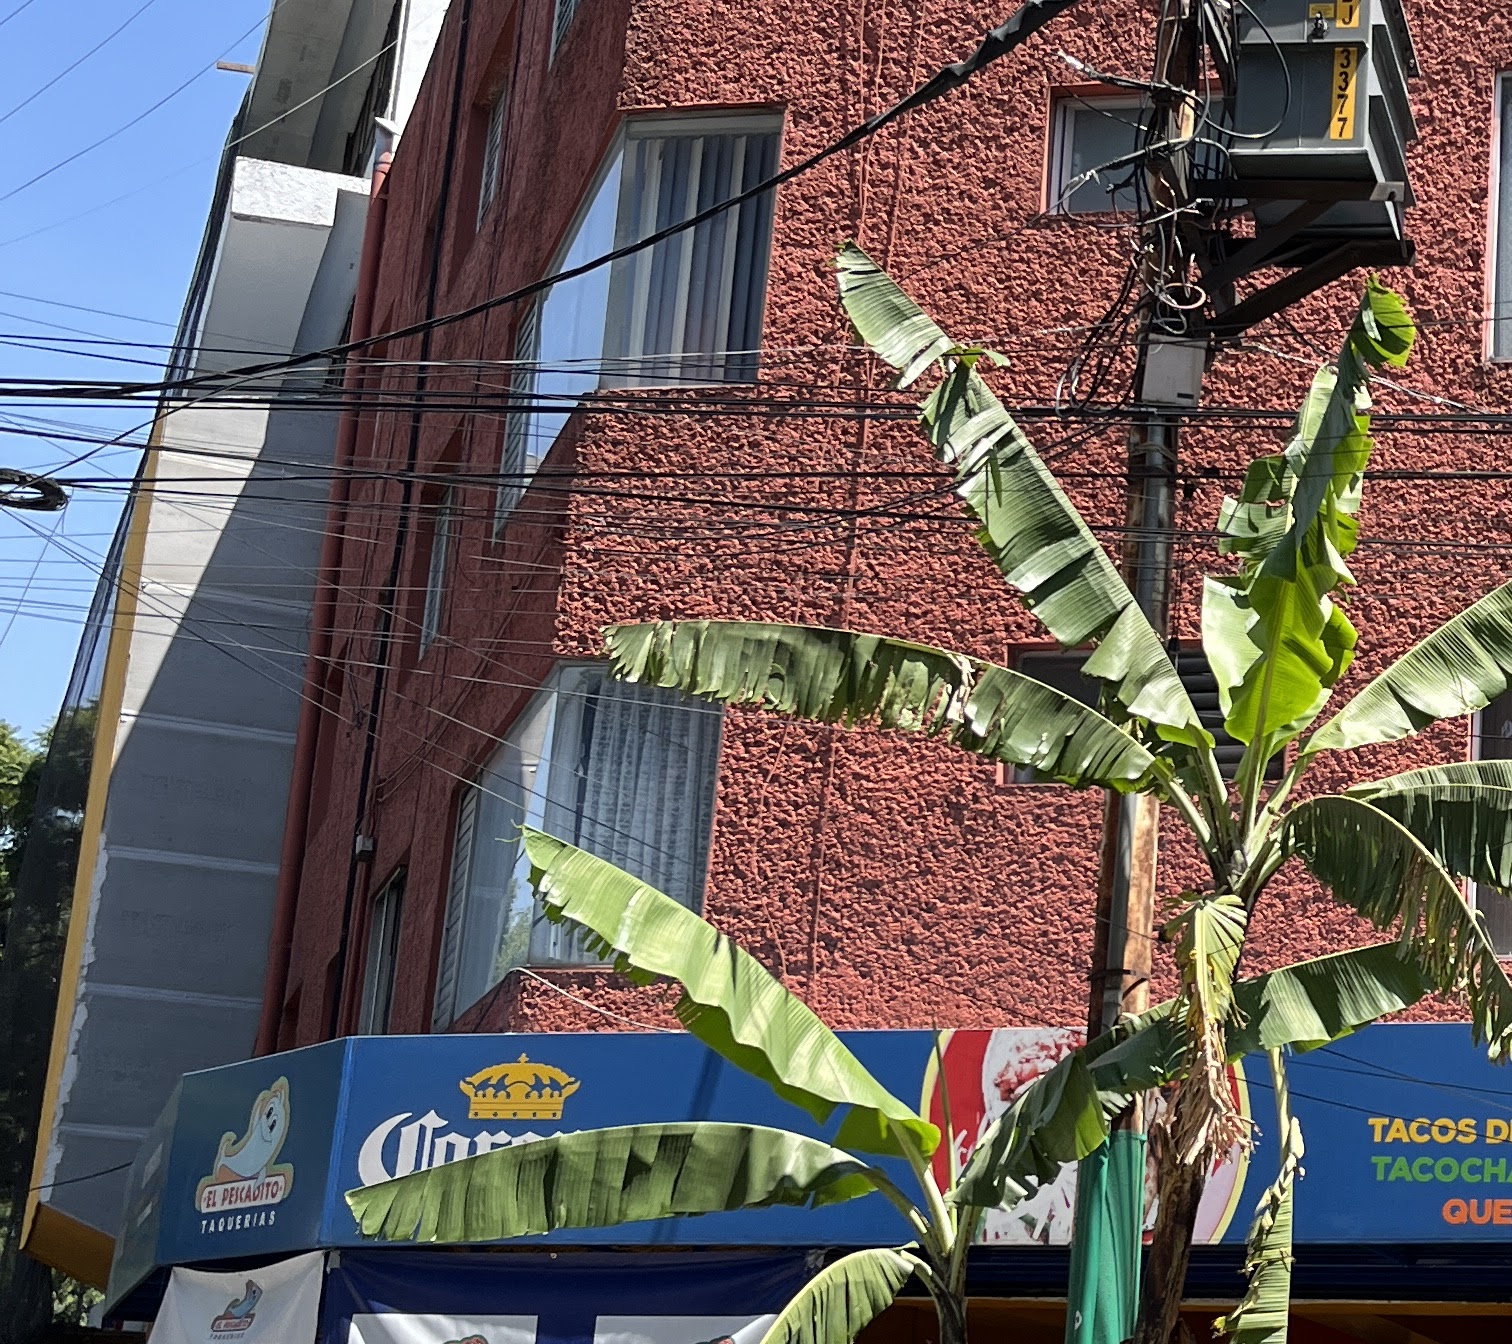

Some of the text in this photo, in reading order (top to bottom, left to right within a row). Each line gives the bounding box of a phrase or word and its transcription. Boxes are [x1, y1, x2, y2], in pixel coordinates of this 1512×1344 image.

[1336, 48, 1352, 138] 3377
[1368, 1118, 1478, 1144] TACOS
[206, 1183, 280, 1209] EL PESCADITO
[201, 1211, 276, 1234] TAQUERIAS
